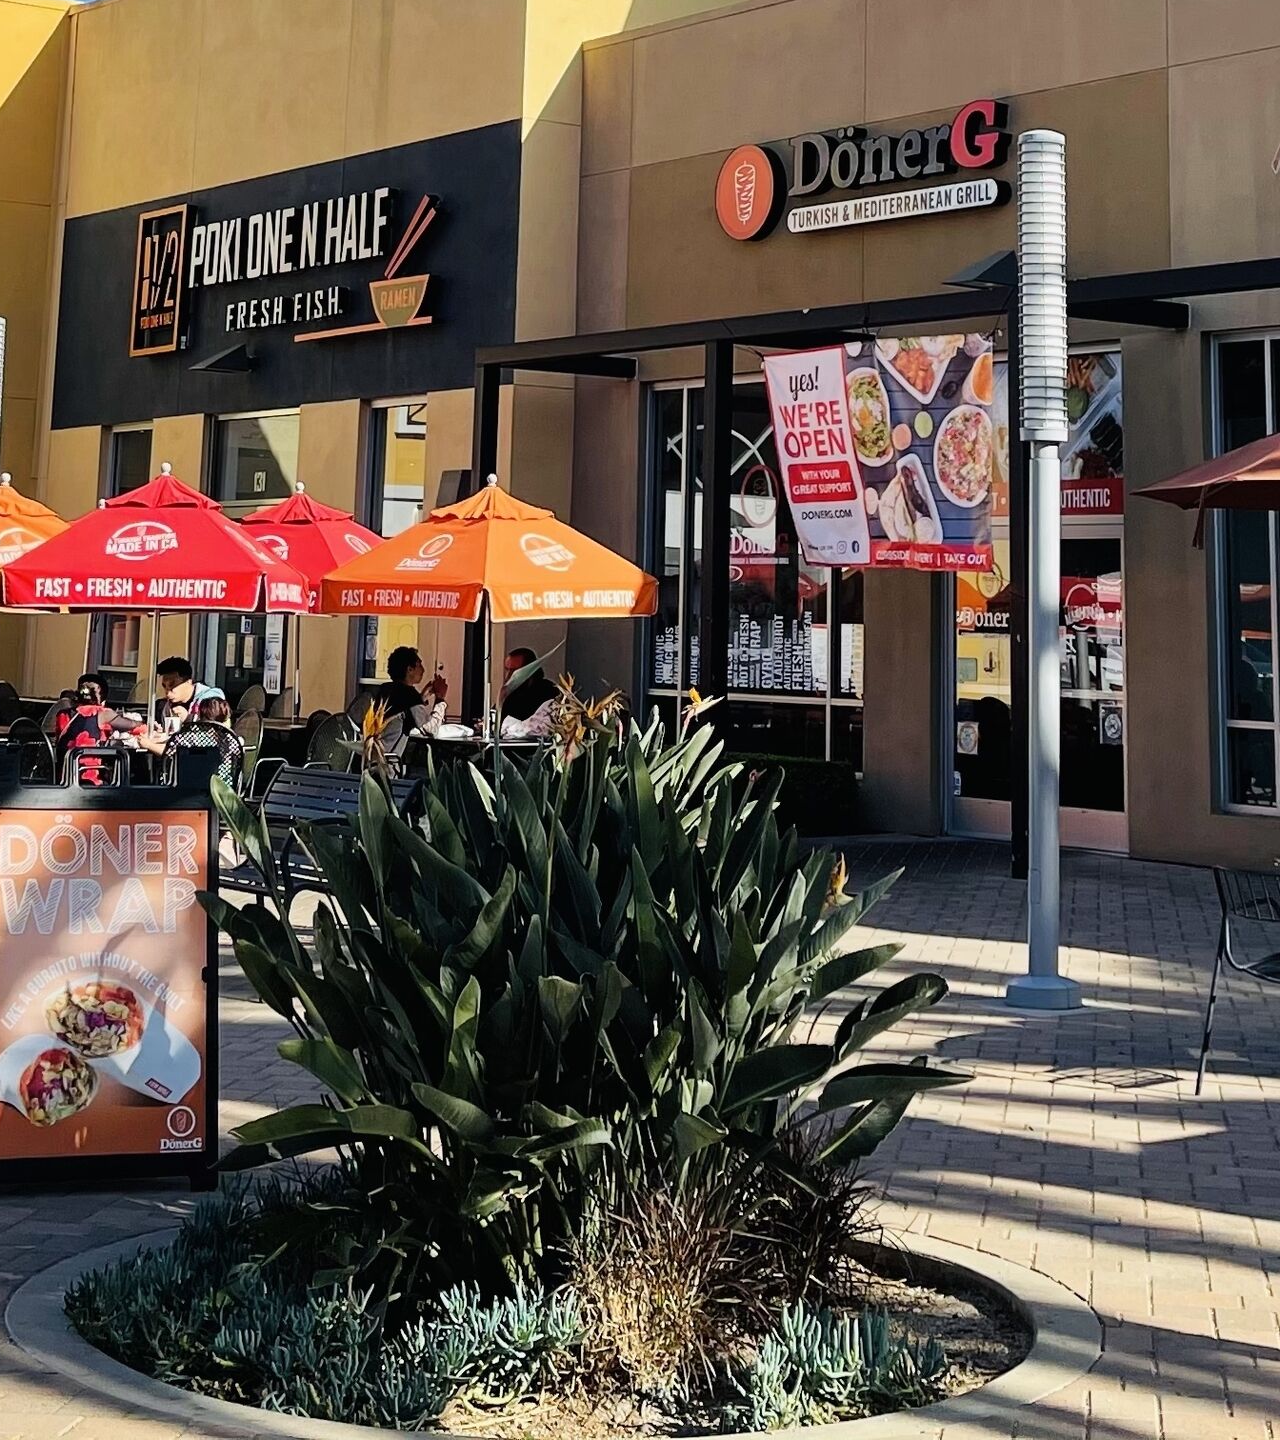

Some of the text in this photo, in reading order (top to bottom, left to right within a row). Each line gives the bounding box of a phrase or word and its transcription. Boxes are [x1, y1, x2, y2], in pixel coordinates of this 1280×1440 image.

[787, 100, 1000, 197] DönerG
[791, 183, 992, 229] TURKISH & MEDITERRANEAN GRILL
[189, 186, 390, 289] POKI ONE N HALF
[226, 286, 343, 332] FRESH FISH
[380, 285, 417, 311] RAMEN
[788, 366, 820, 401] yes!
[779, 400, 843, 429] WE'RE
[784, 428, 847, 459] OPEN
[792, 481, 852, 496] GREAT SUPPORT
[801, 468, 841, 482] WITH YOUR
[1060, 487, 1112, 509] UTHENTIC
[105, 541, 143, 555] MADE
[943, 553, 966, 565] TAKE
[35, 577, 228, 600] FAST FRESH AUTHENTIC
[341, 588, 460, 610] FAST FRESH AUTHENTIC
[510, 588, 636, 610] FAST FRESH AUTHENTIC
[739, 613, 750, 651] FRESH
[749, 619, 761, 662] WRAP
[654, 633, 665, 685] ORGANIC
[773, 613, 784, 690] FLADENBROT
[783, 637, 792, 691] AUTHENTIC
[791, 645, 804, 691] FRESH
[803, 610, 813, 692] MEDITERRANEAN
[738, 664, 750, 688] HOT
[761, 653, 773, 689] GYRO
[0, 877, 198, 935] WRAP
[0, 951, 186, 1031] LIKE A BURRITO WITHOUT THE GUILT
[160, 1136, 203, 1151] DönerG
